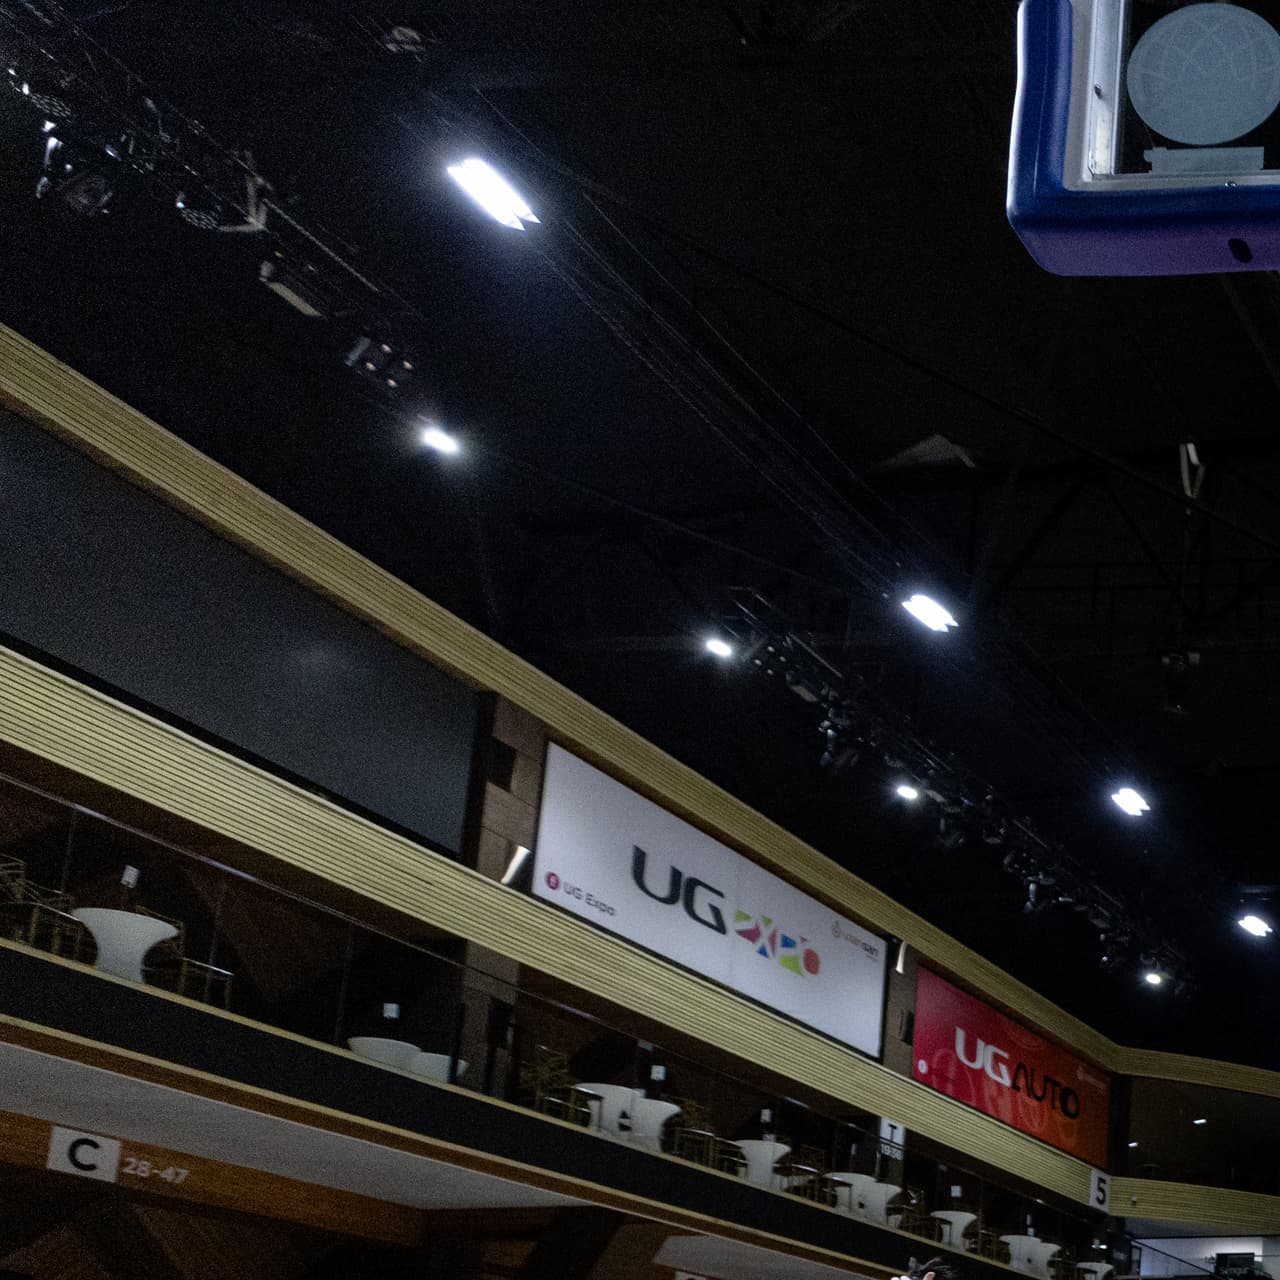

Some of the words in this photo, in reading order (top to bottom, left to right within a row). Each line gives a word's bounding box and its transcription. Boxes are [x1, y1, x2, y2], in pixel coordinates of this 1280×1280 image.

[562, 881, 583, 900] UG
[584, 893, 617, 916] Expo
[631, 844, 728, 936] UG
[954, 1026, 1012, 1088] UG
[1011, 1061, 1081, 1120] AUTO
[68, 1137, 100, 1171] C
[121, 1156, 192, 1184] 28-47
[1096, 1176, 1106, 1206] 5
